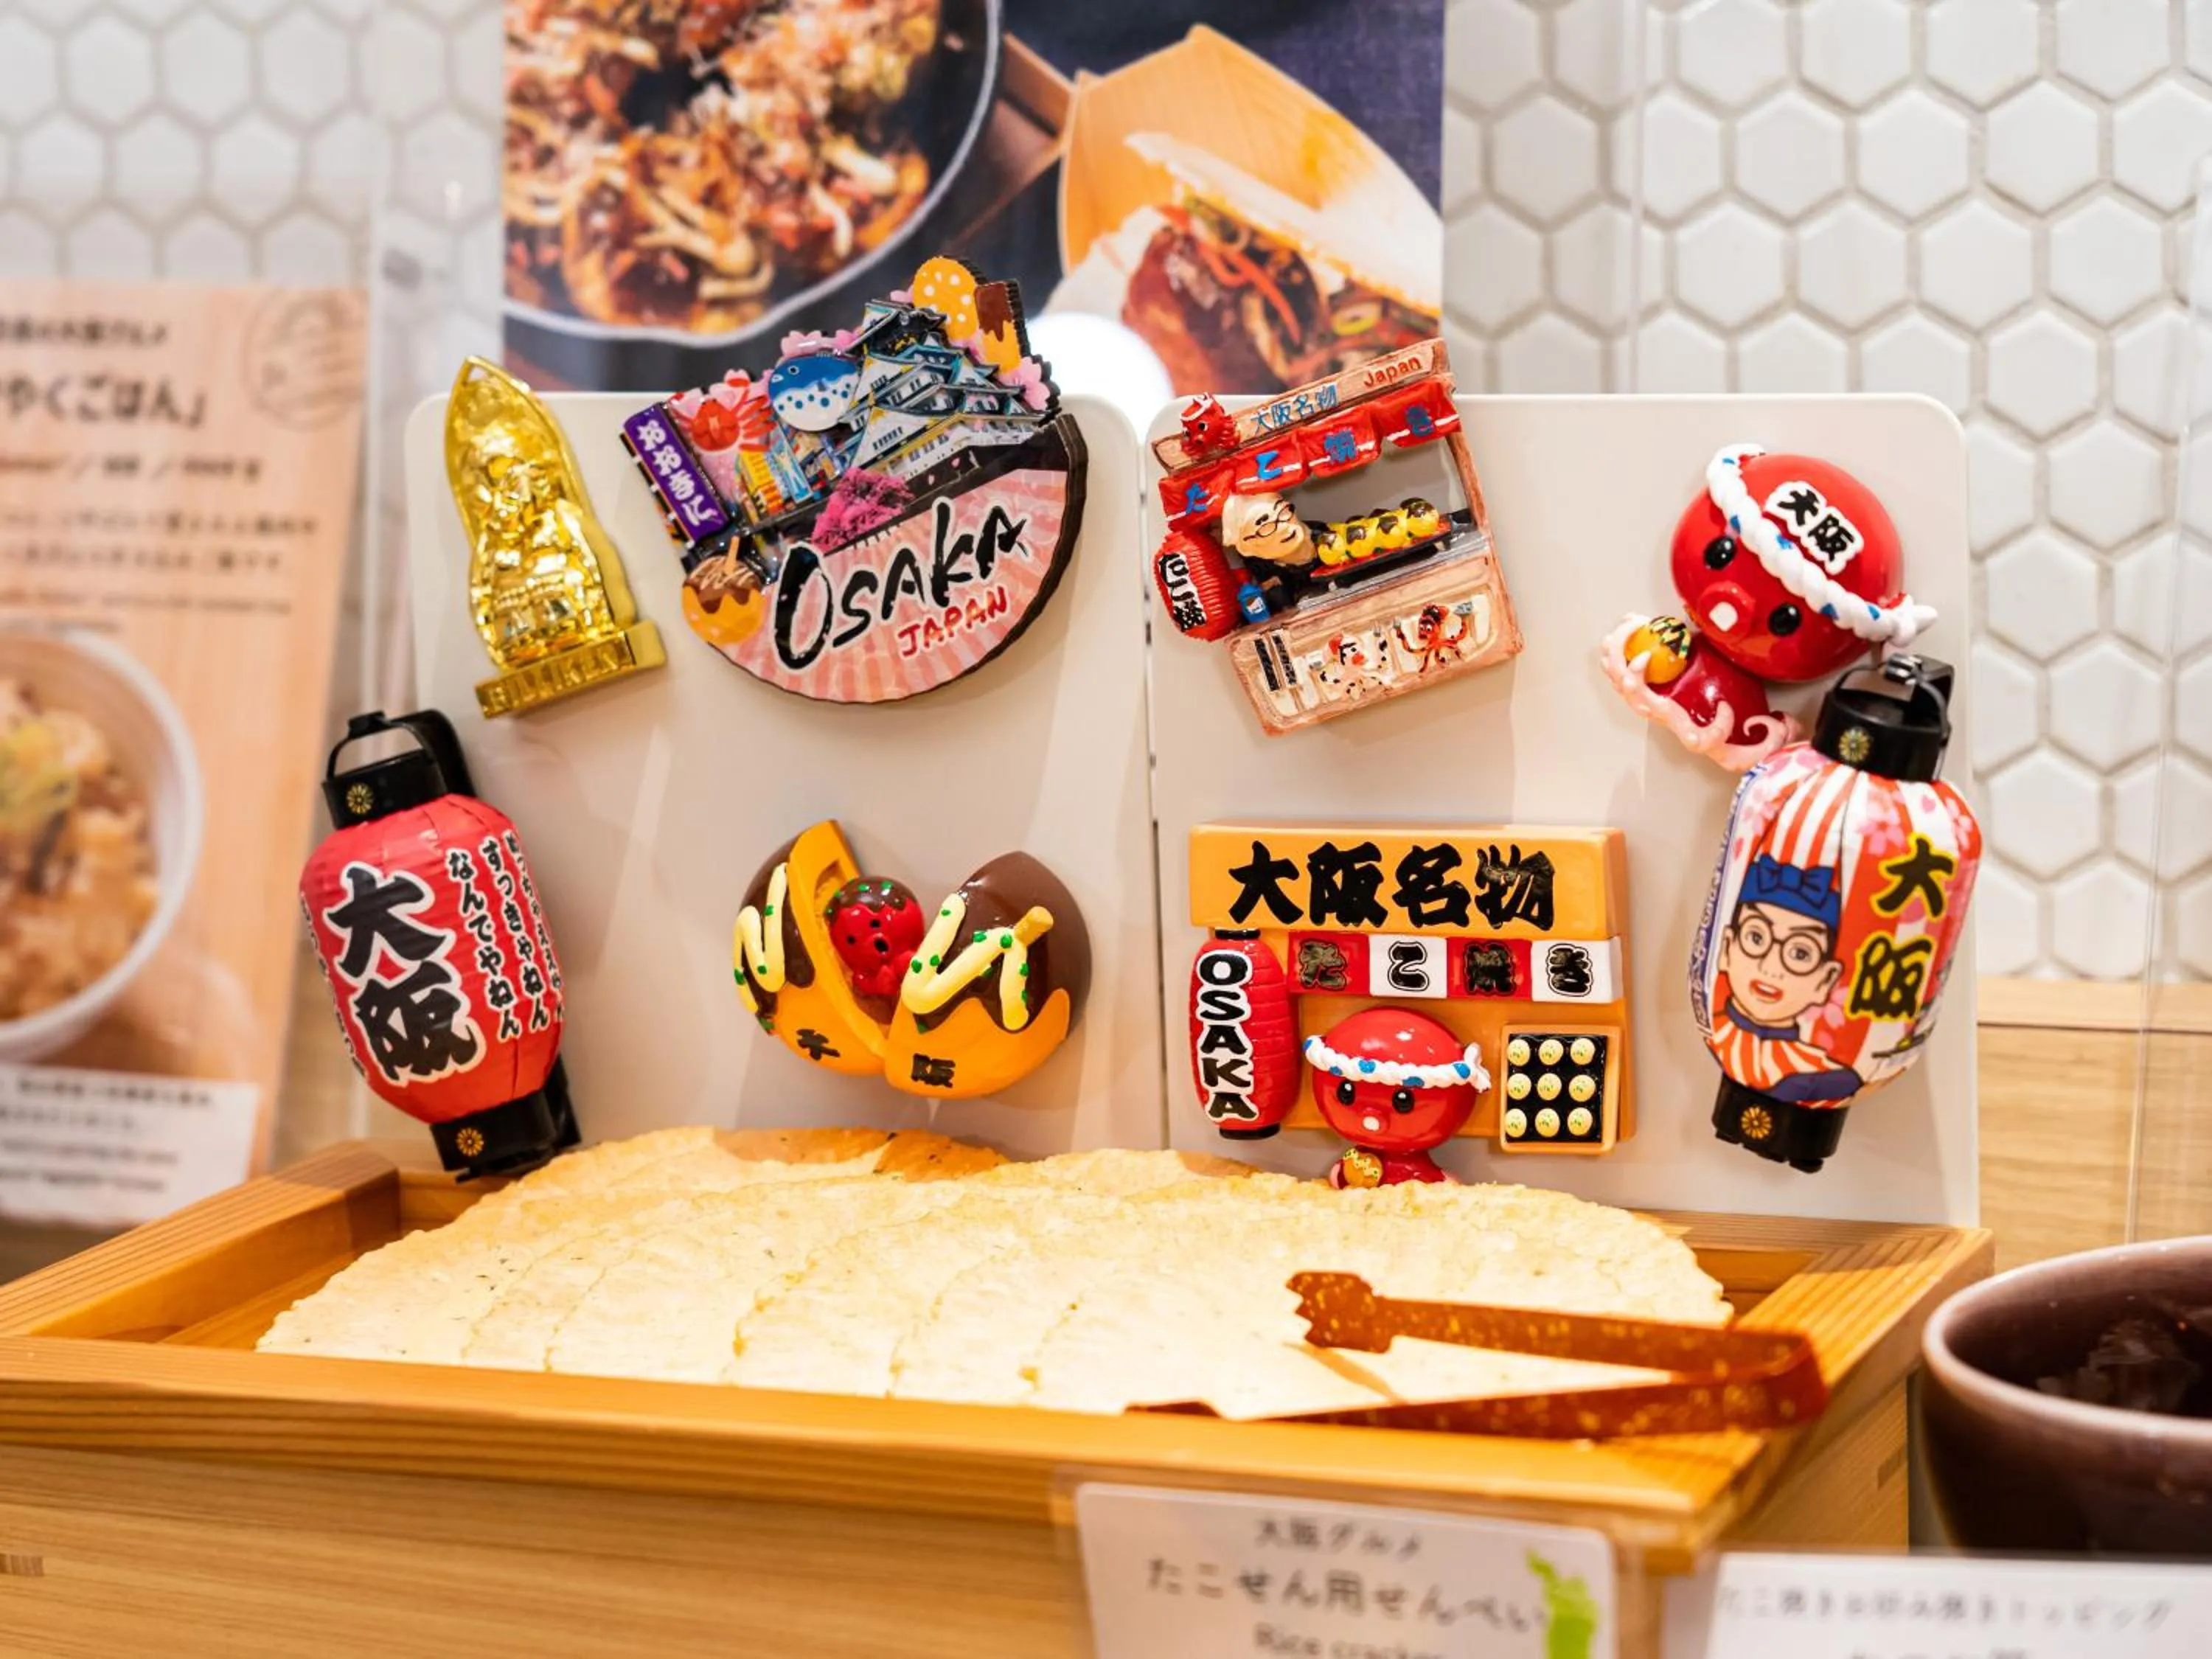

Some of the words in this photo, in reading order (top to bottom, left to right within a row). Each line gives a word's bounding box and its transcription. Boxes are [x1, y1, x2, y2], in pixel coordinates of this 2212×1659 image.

[1251, 383, 1338, 435] 大阪名物
[1363, 355, 1422, 388] Japan
[1778, 488, 1855, 563] 大阪
[897, 586, 1008, 658] JAPAN
[1228, 840, 1557, 931] 大阪名物
[448, 850, 520, 1040] なんでやねん
[1299, 940, 1594, 998] たこ焼き
[1850, 838, 1954, 1019] 大阪
[326, 866, 479, 1080] 大阪
[1197, 953, 1258, 1119] OSAKA
